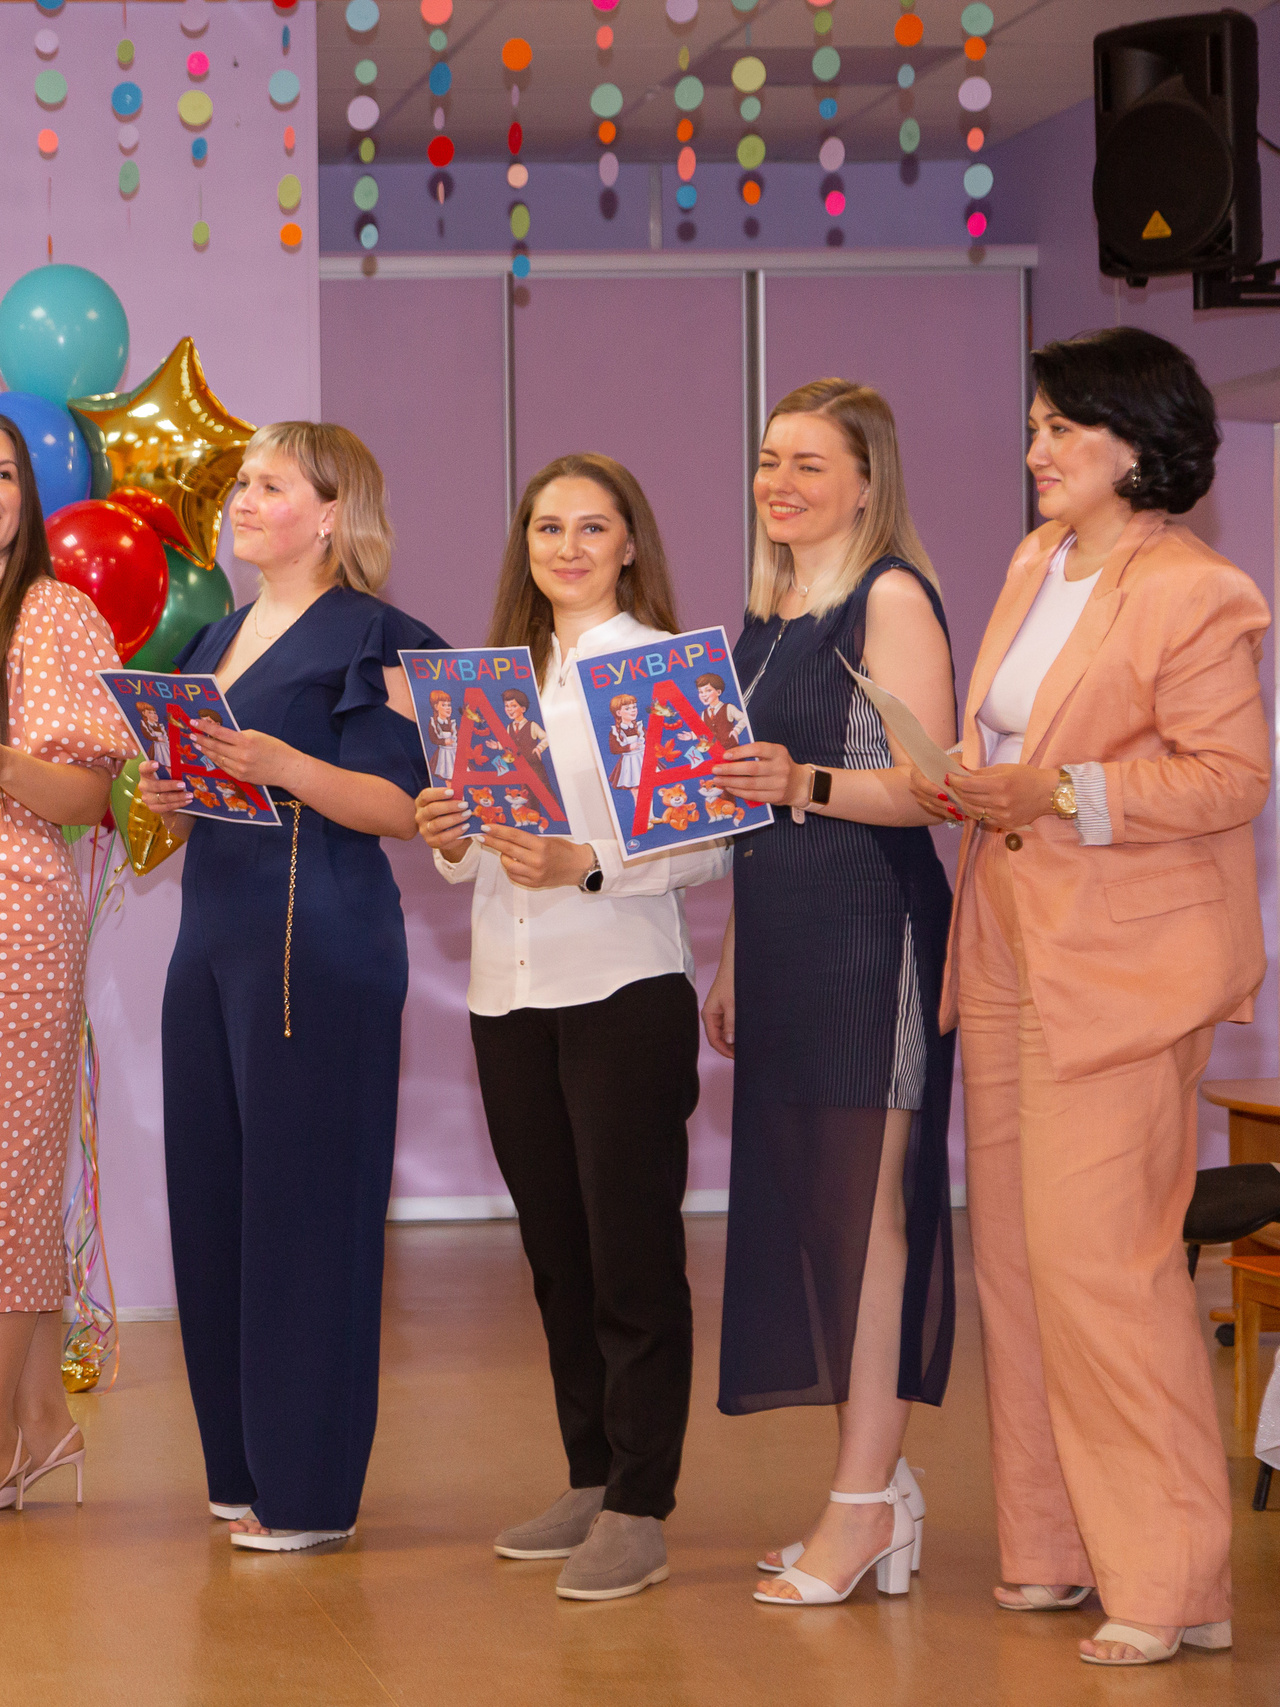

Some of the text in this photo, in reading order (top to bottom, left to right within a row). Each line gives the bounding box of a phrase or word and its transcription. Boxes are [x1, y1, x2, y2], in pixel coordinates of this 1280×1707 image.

[412, 657, 531, 681] БУКВАРЬ
[590, 641, 726, 689] БУКВАРЬ
[113, 679, 220, 701] БУКВАРЬ
